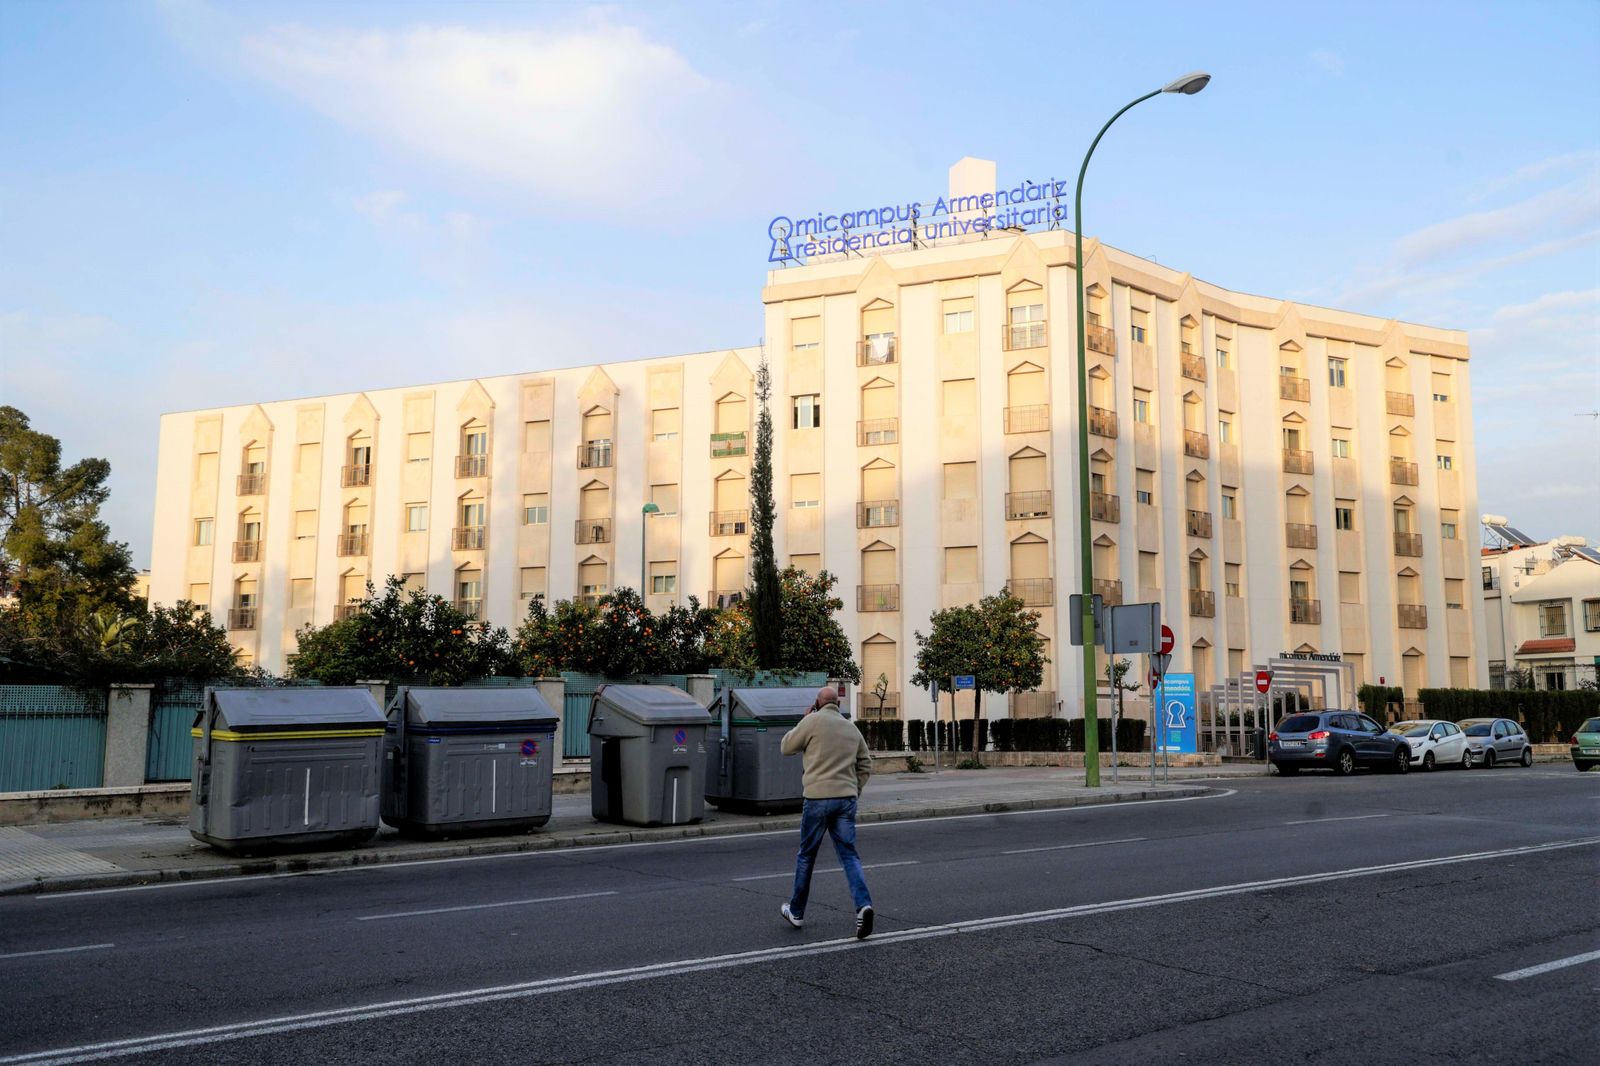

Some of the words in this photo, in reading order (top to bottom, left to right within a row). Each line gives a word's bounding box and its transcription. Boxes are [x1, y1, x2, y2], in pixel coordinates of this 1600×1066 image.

[795, 200, 921, 236] micampus
[795, 226, 913, 258] residencia
[924, 201, 1068, 240] universitaria
